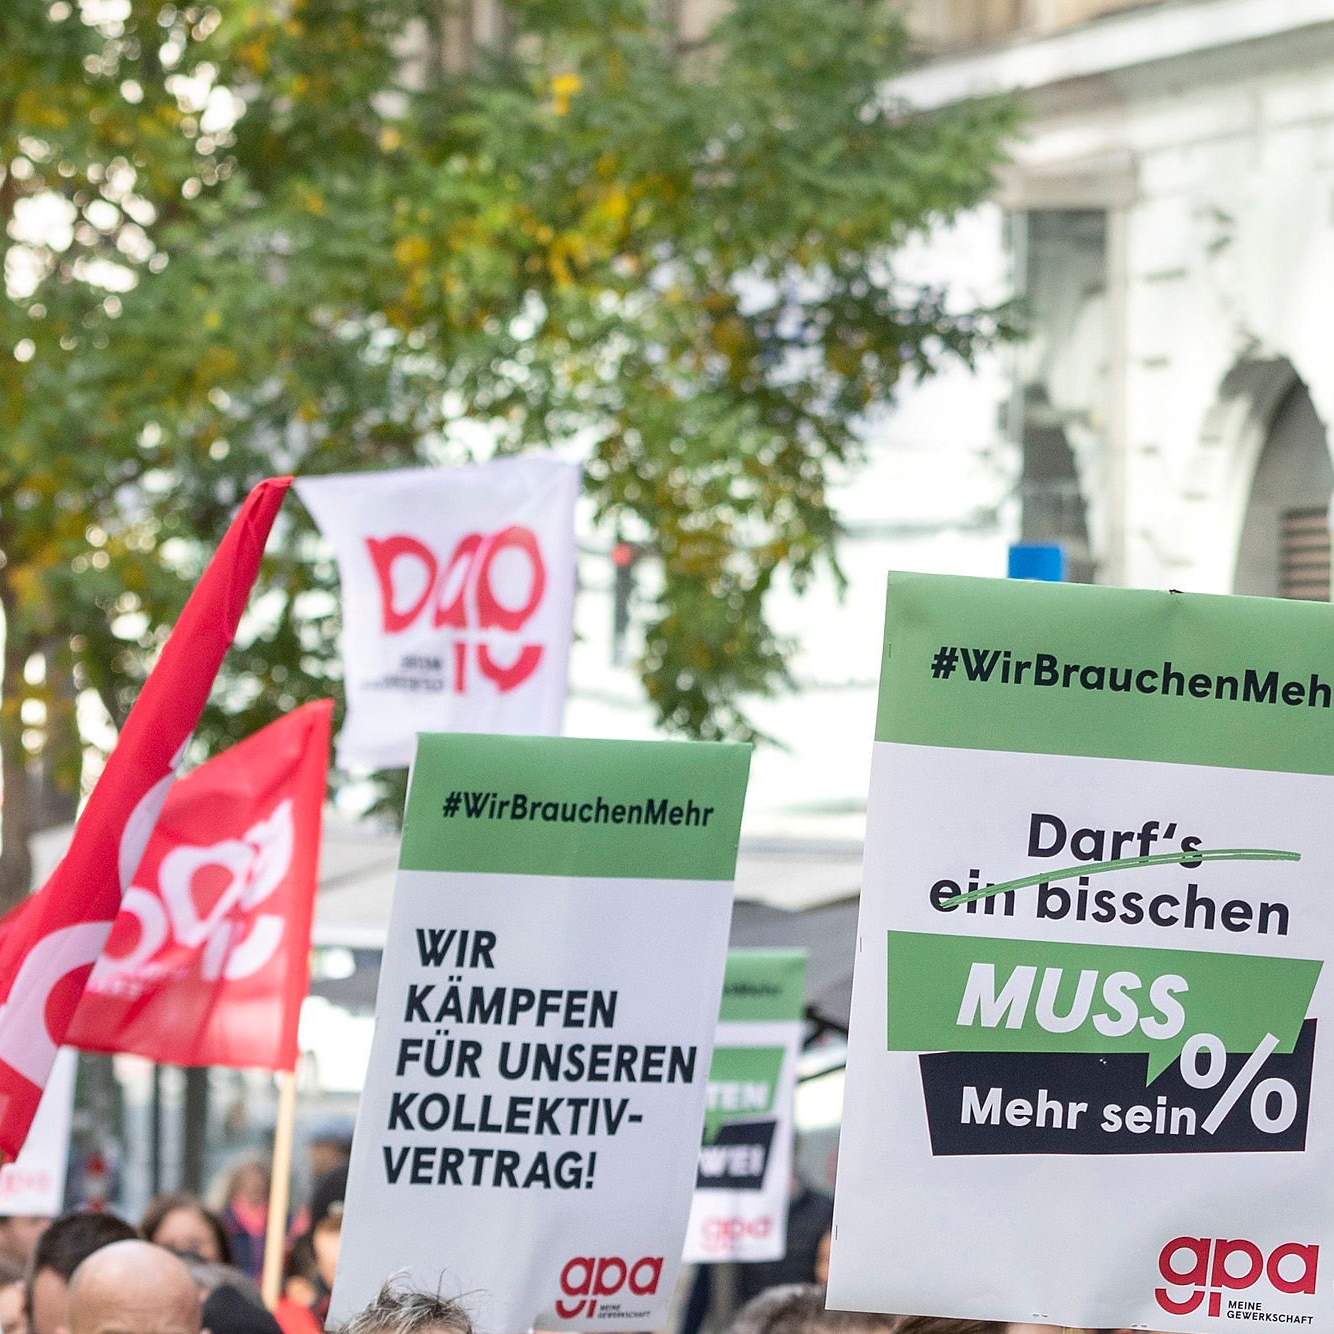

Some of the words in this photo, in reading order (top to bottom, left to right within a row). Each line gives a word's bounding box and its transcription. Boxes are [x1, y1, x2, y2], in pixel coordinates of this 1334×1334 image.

[442, 790, 714, 828] #WirBrauchenMehr
[930, 868, 1015, 918] ein
[1035, 874, 1290, 937] bisschen
[415, 928, 497, 969] WIR
[403, 975, 618, 1029] KÄMPFEN
[955, 962, 1189, 1041] MUSS
[394, 1029, 483, 1078] FÜR
[497, 1041, 697, 1084] UNSEREN
[387, 1092, 643, 1137] KOLLEKTIV-
[959, 1085, 1087, 1131] Mehr
[1099, 1096, 1196, 1136] sein
[382, 1146, 598, 1190] VERTRAG!
[555, 1256, 663, 1320] gpa
[1154, 1236, 1320, 1317] gpa
[1226, 1309, 1314, 1325] GEWERKSCHAFT
[1228, 1300, 1262, 1312] MEINE
